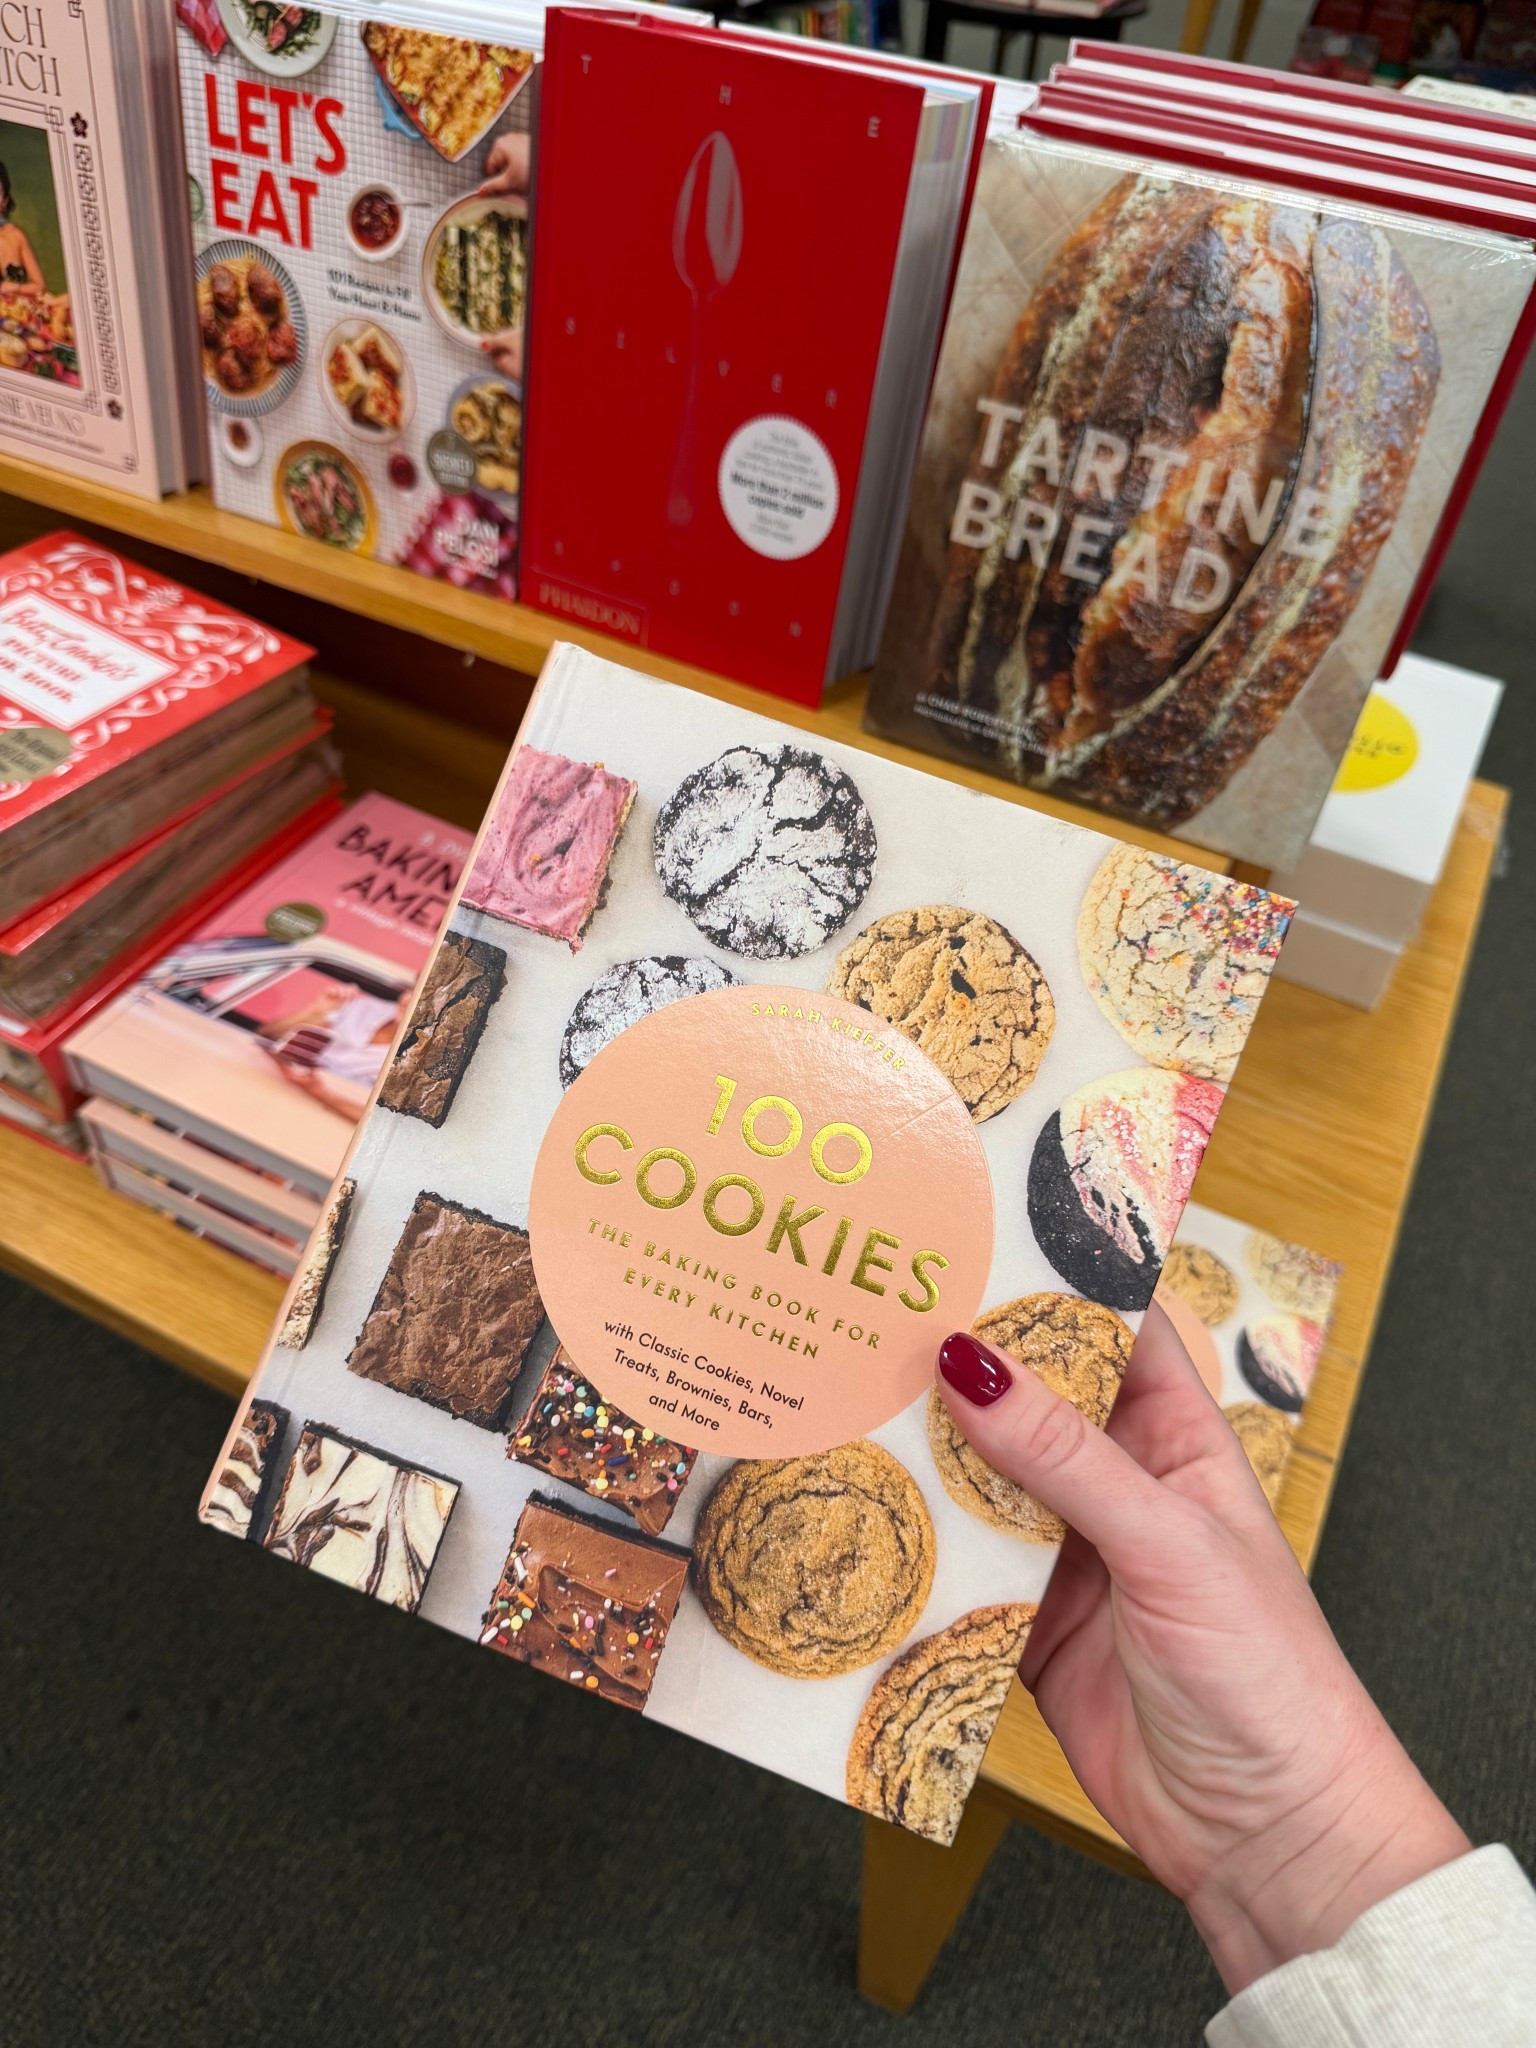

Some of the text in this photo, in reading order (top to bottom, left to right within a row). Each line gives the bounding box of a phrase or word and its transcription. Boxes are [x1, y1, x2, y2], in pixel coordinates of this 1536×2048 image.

[204, 73, 347, 175] LET'S
[208, 159, 320, 251] EAT
[976, 399, 1343, 558] TARTINE
[949, 479, 1234, 616] BREAD
[340, 872, 453, 931] AME
[751, 1001, 907, 1073] SARAH KIEFFER
[704, 1072, 873, 1186] 100
[573, 1122, 951, 1314] COOKIES
[587, 1218, 881, 1351] THE BAKING BOOK FOR
[623, 1267, 821, 1360] EVERY KITCHEN
[604, 1318, 805, 1412] with Classic Cookies, Novel
[614, 1347, 775, 1430] Treats, Brownies, Bars,
[648, 1391, 720, 1432] and More
